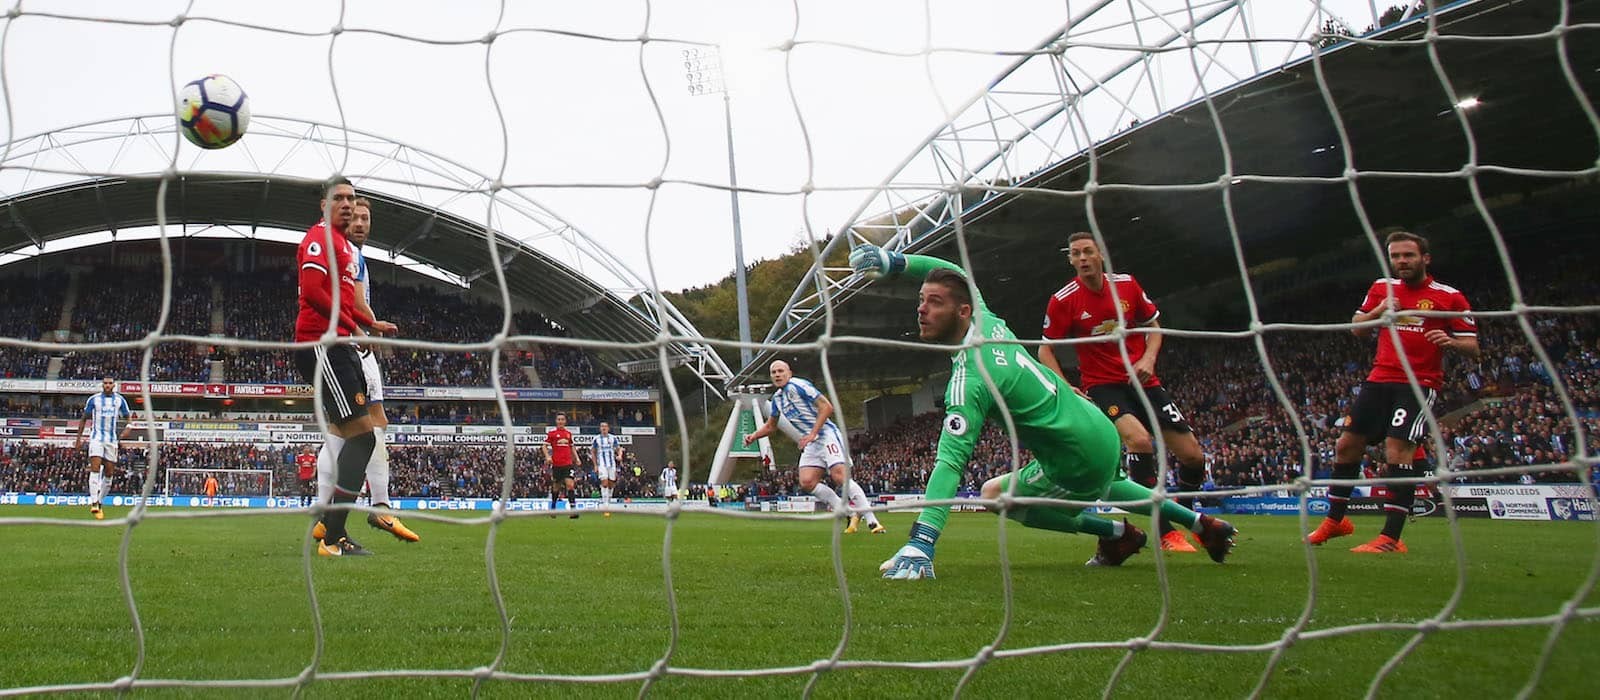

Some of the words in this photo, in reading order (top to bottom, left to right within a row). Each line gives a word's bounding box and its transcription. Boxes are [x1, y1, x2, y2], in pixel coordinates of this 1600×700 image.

[991, 347, 1008, 366] DE
[1015, 350, 1057, 396] 1
[150, 384, 182, 393] FANTASTIC
[234, 385, 265, 394] FANTASTIC
[1392, 408, 1407, 427] 8
[826, 443, 839, 456] 10
[1517, 488, 1540, 496] LEEDS
